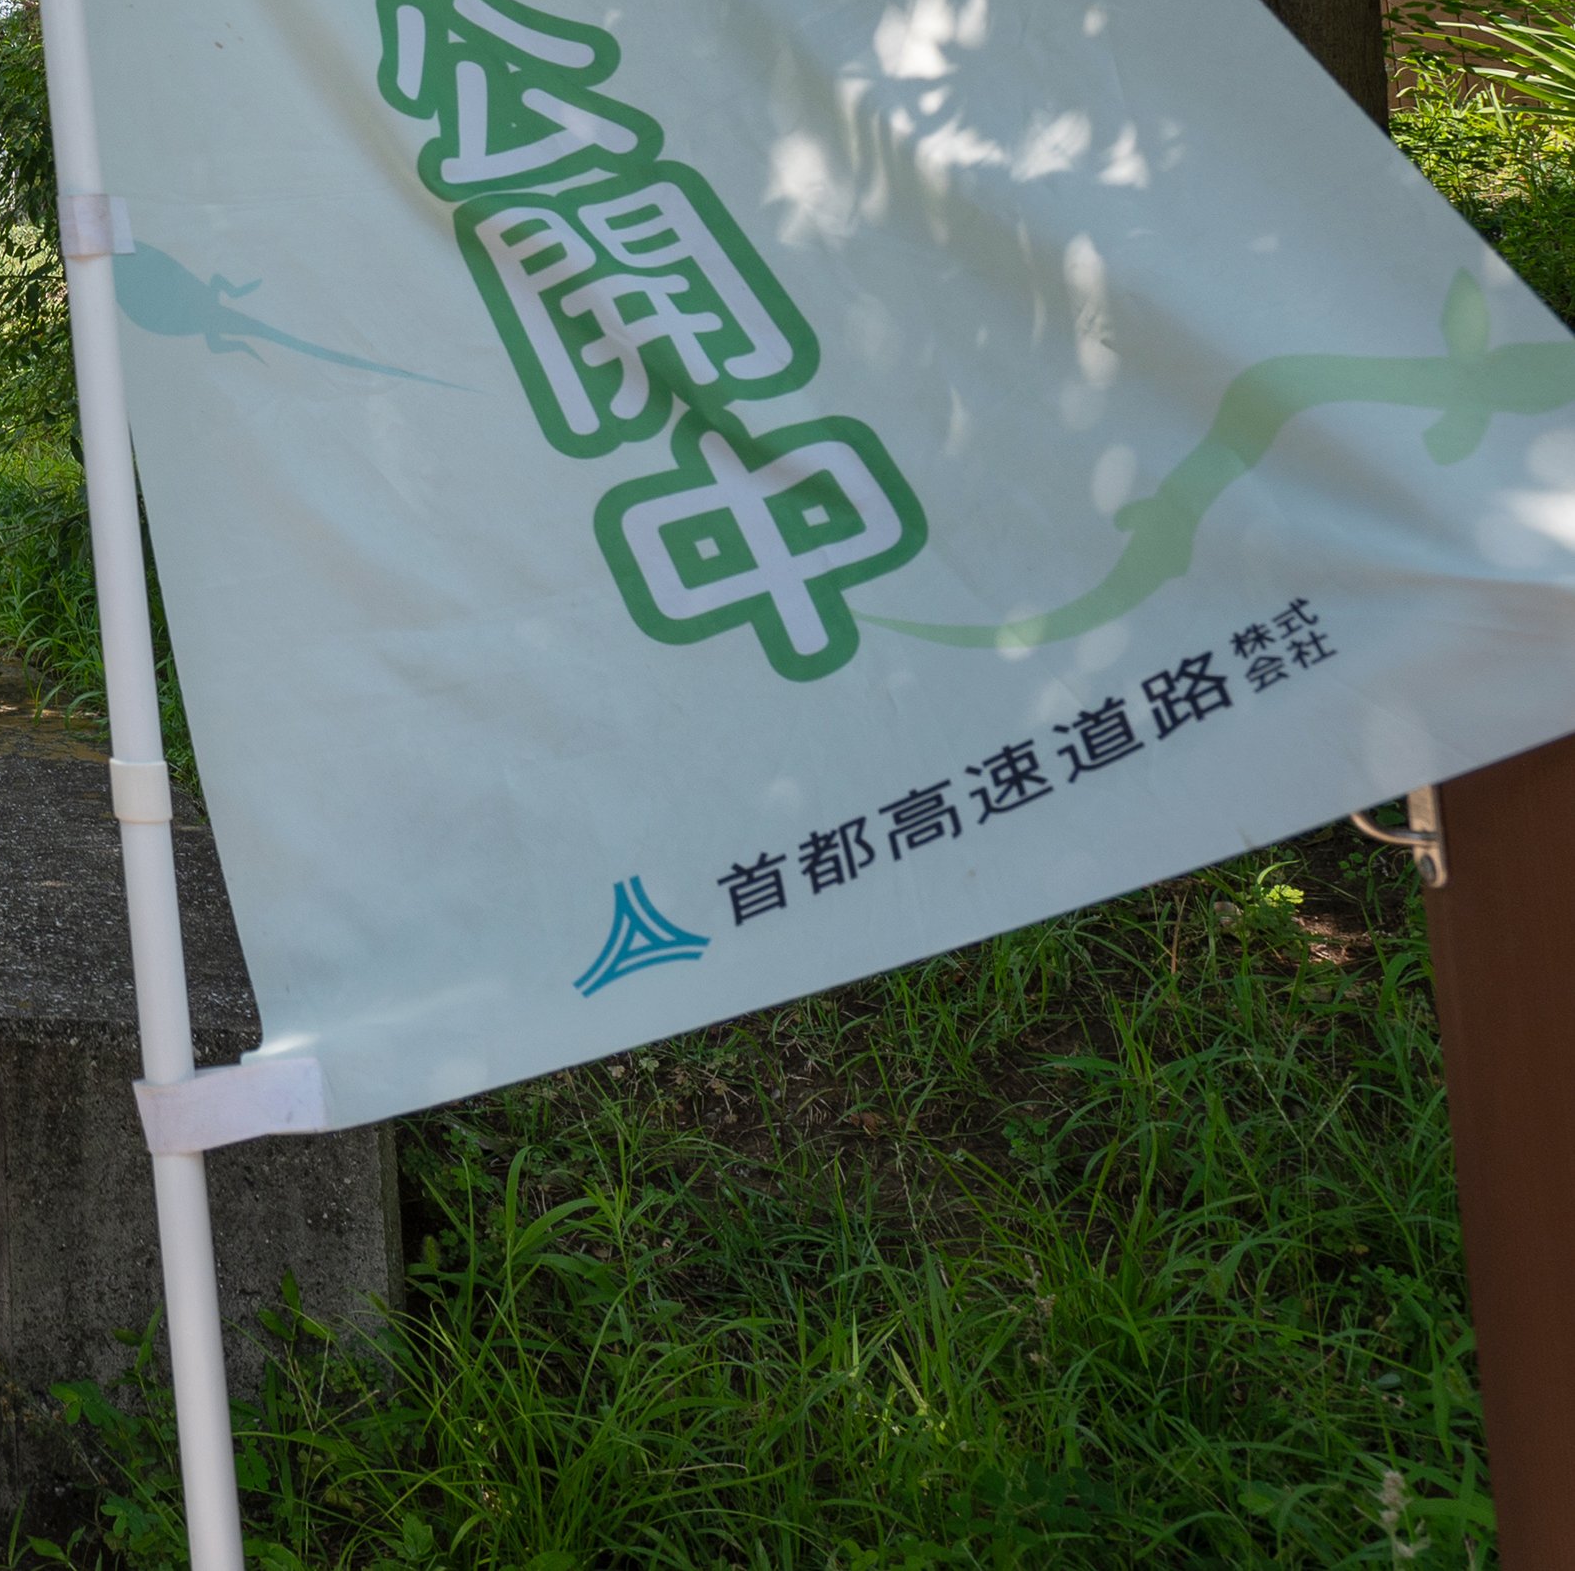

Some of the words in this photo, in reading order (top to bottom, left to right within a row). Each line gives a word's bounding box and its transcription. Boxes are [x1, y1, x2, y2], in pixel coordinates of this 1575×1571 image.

[1229, 597, 1319, 660] 株式
[1245, 630, 1337, 694] 会社
[716, 650, 1235, 927] 首都高速道路
